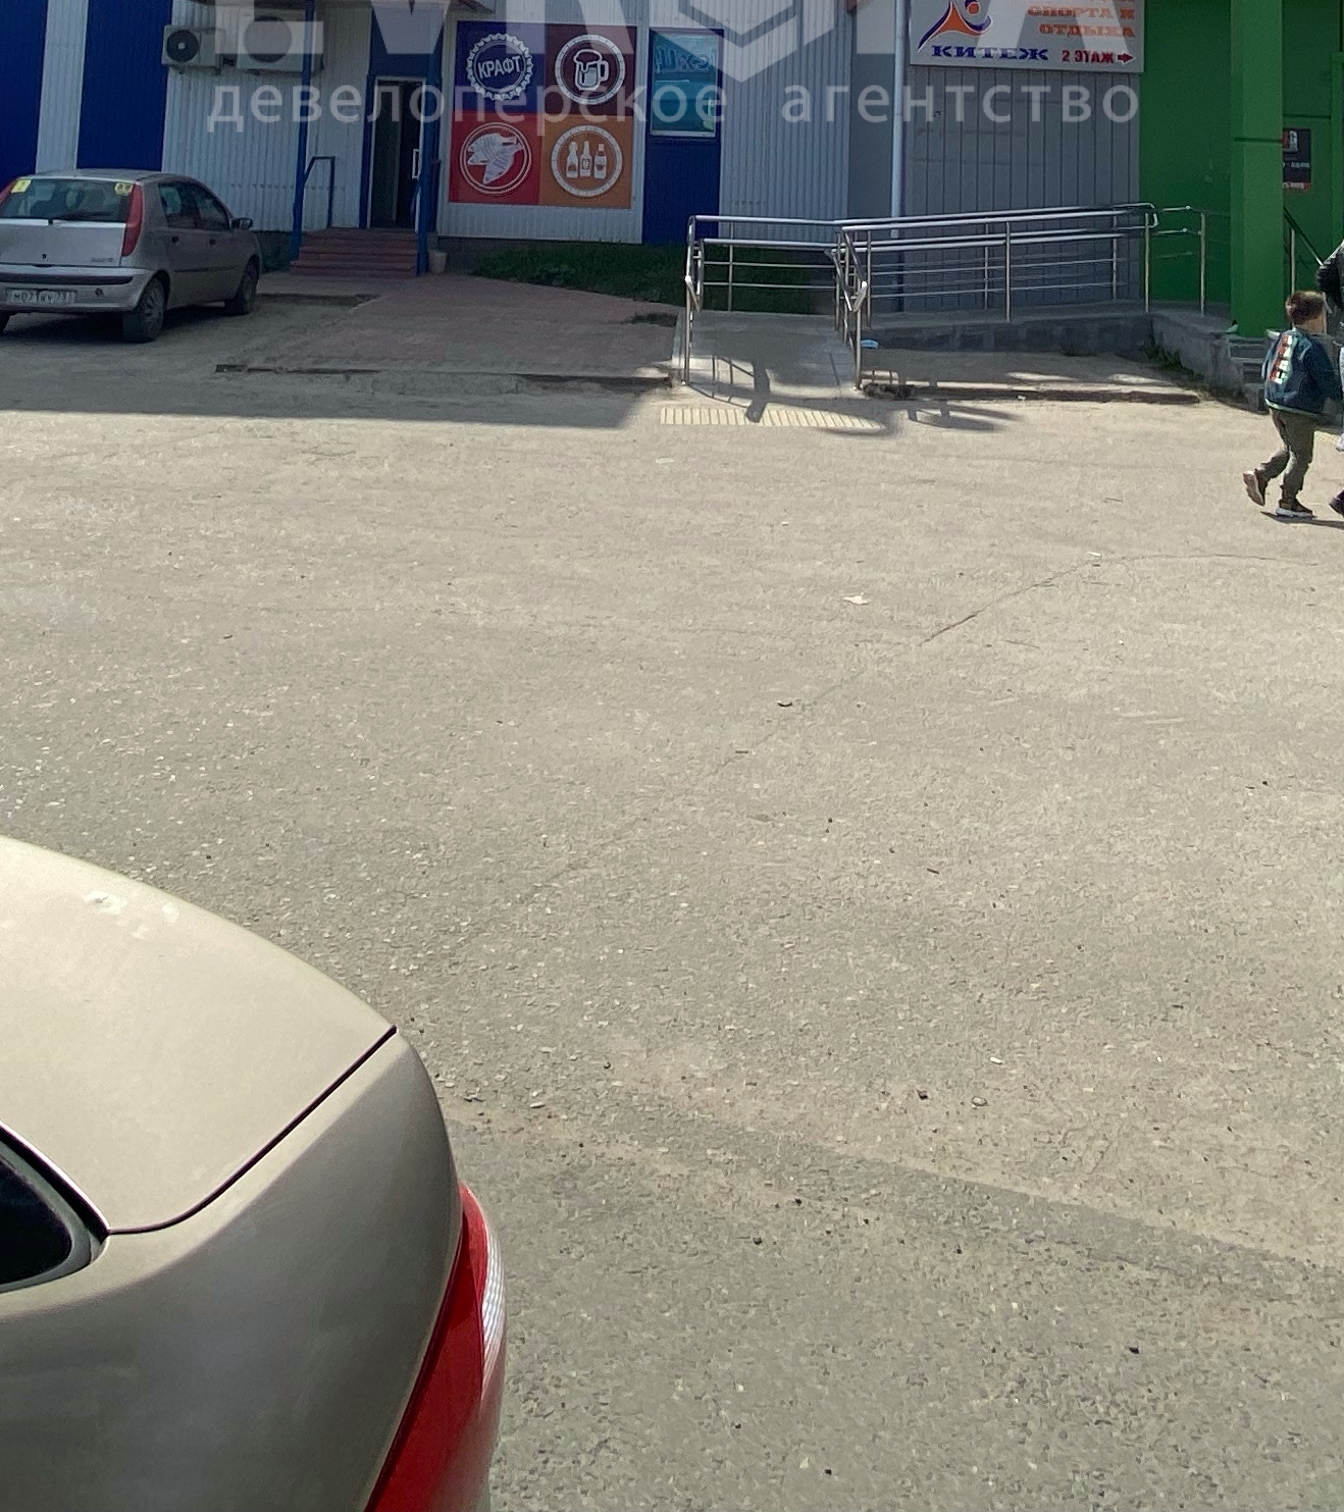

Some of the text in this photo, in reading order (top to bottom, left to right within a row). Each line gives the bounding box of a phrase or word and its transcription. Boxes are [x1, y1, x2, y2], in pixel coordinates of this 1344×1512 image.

[1027, 5, 1135, 19] СПОРТА И
[1039, 23, 1135, 37] ОТДЫХА
[931, 45, 1115, 64] КИТЕЖ 2 ЭТАЖ
[477, 56, 523, 80] КРАФТ
